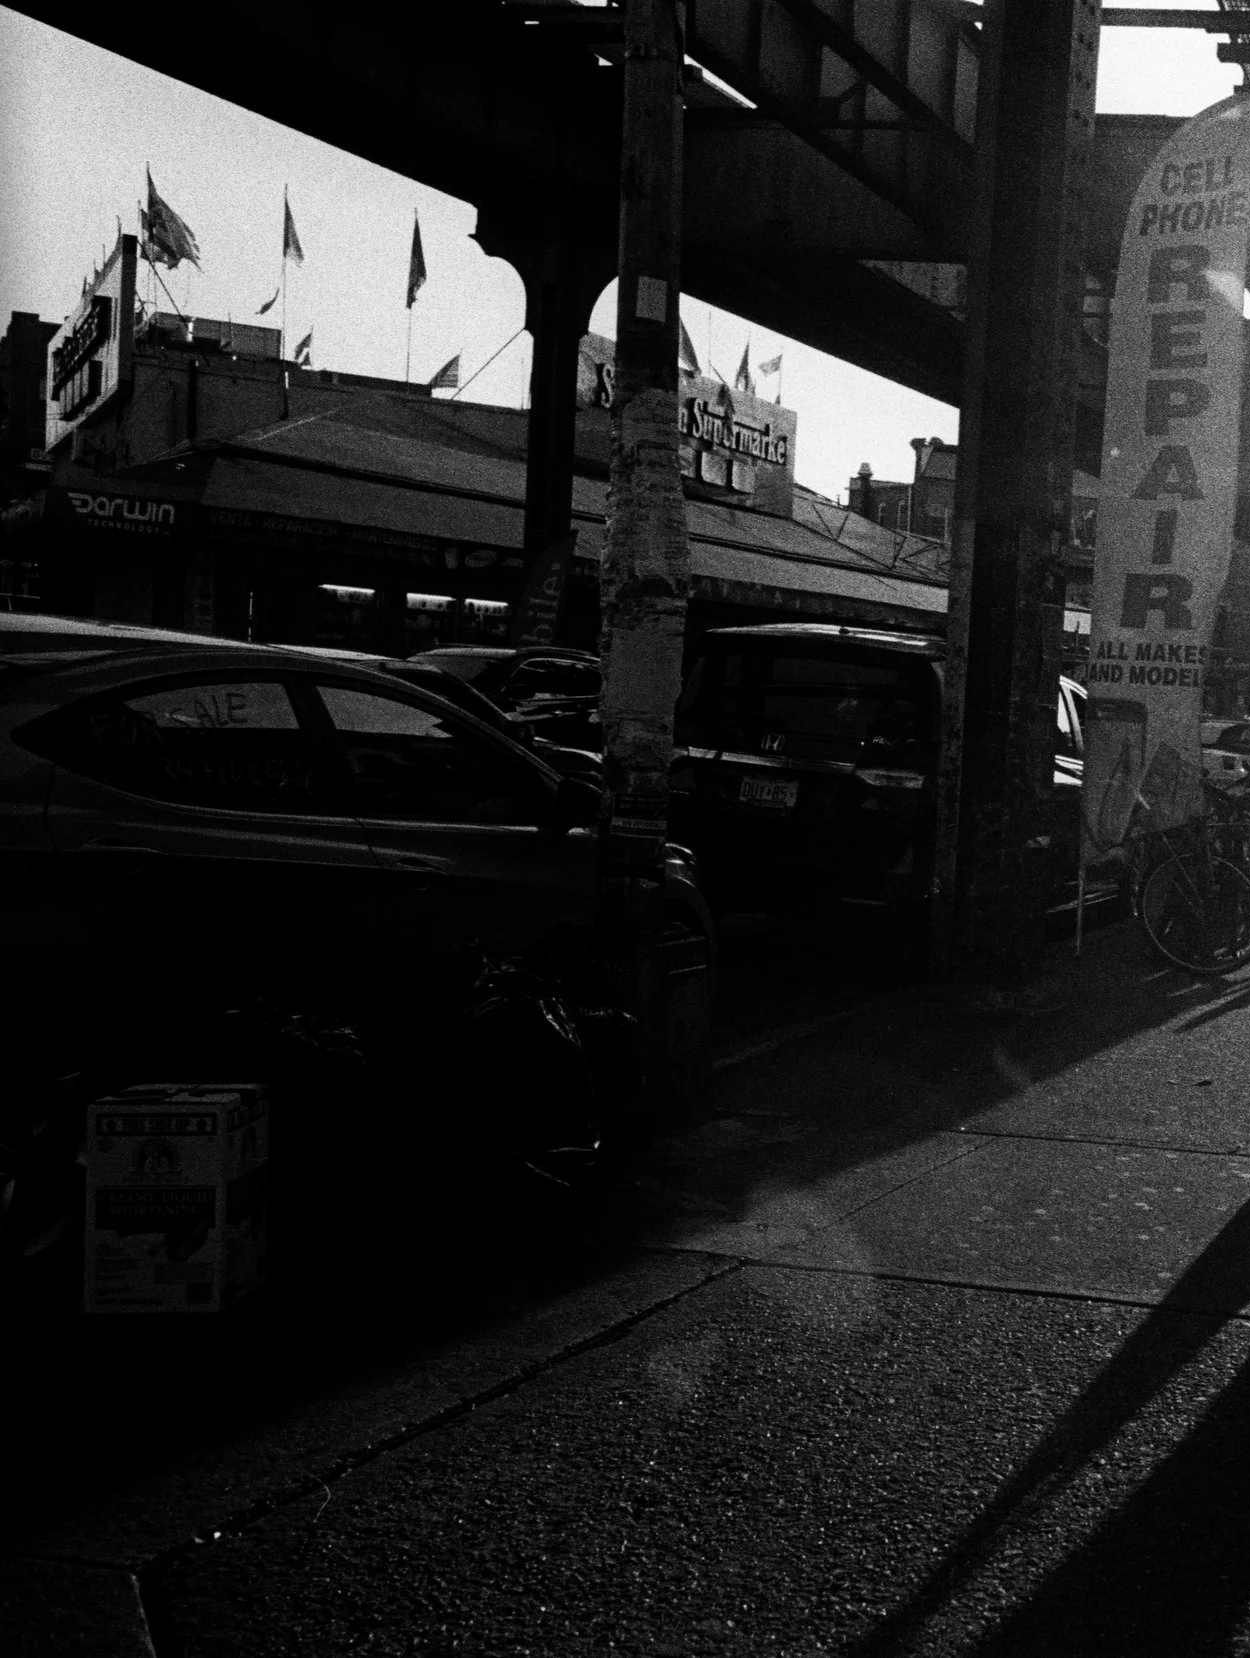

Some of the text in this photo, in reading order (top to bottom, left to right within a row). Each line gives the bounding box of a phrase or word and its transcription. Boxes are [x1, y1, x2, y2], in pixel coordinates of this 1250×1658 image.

[1139, 193, 1247, 237] PHONE
[1120, 245, 1212, 630] REPAIR
[1096, 641, 1128, 660] ALL
[1087, 662, 1123, 683] AND
